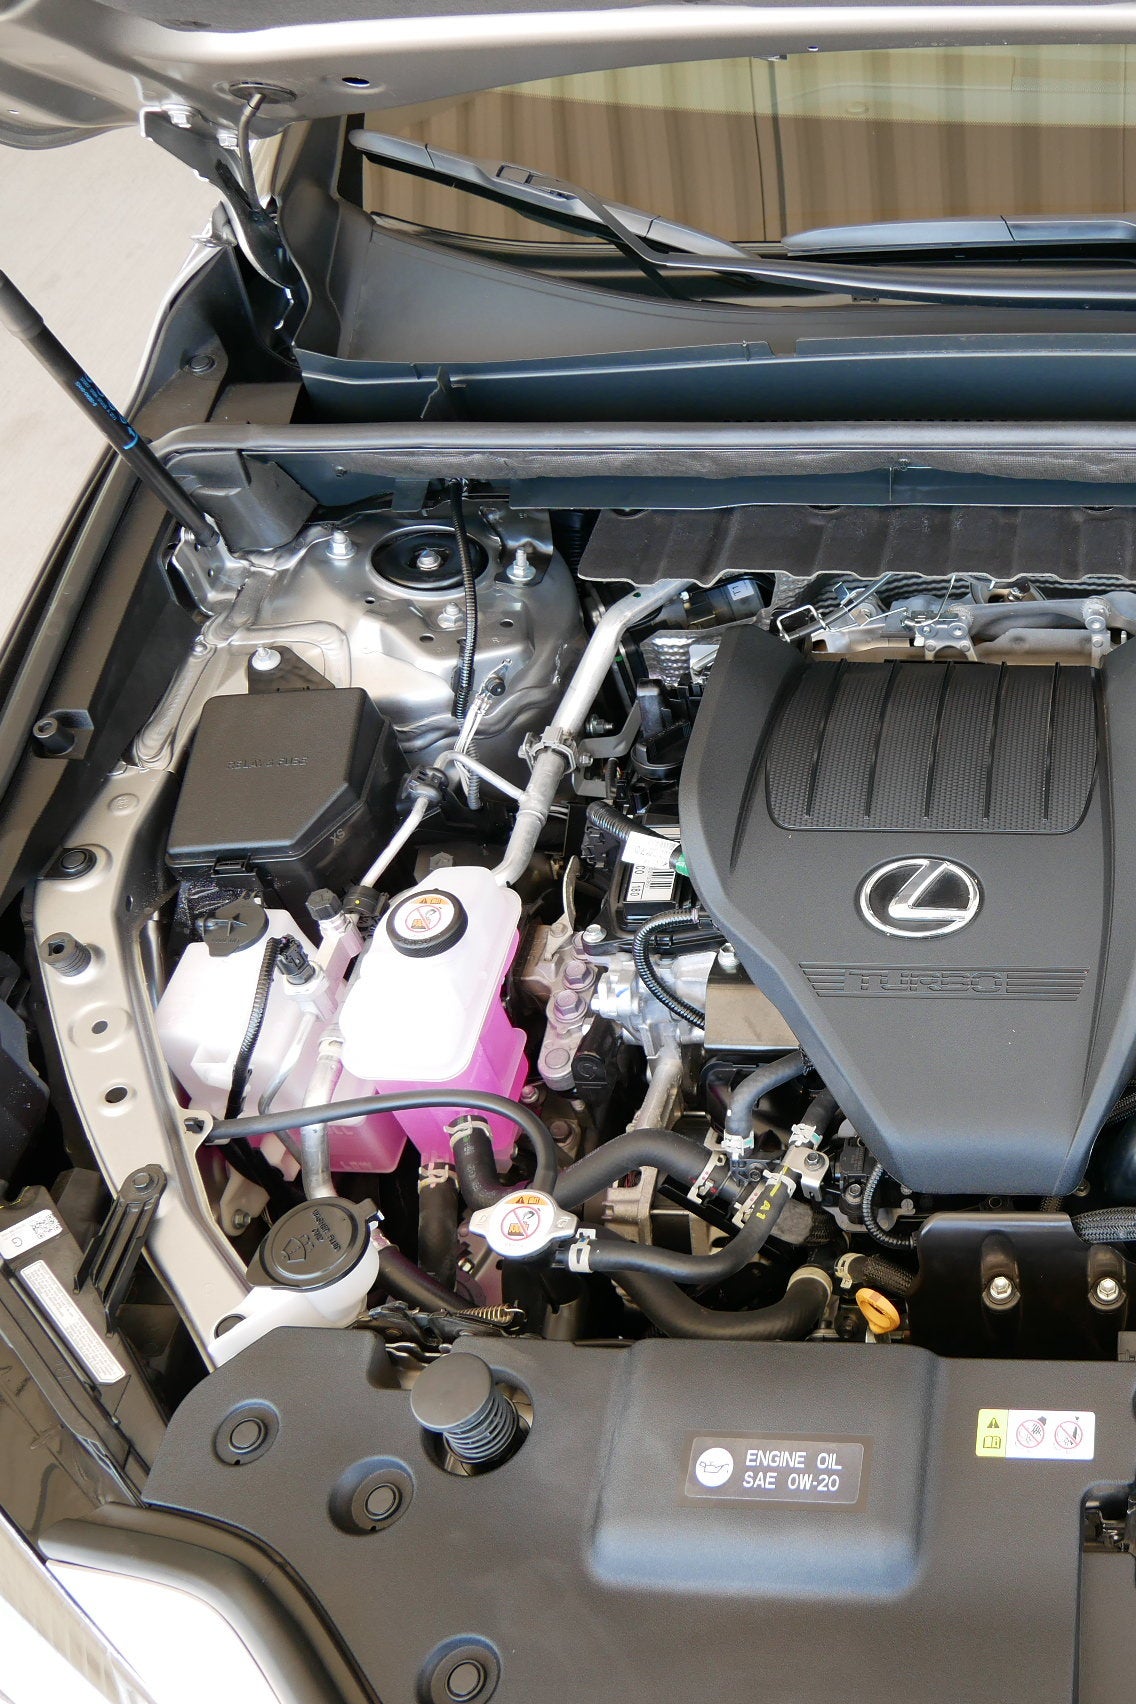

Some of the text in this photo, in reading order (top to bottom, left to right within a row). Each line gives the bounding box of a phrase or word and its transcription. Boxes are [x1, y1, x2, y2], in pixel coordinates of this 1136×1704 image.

[849, 970, 1006, 993] TURBO
[745, 1449, 842, 1470] ENGINE OIL
[742, 1472, 839, 1491] SAE 0W-20
